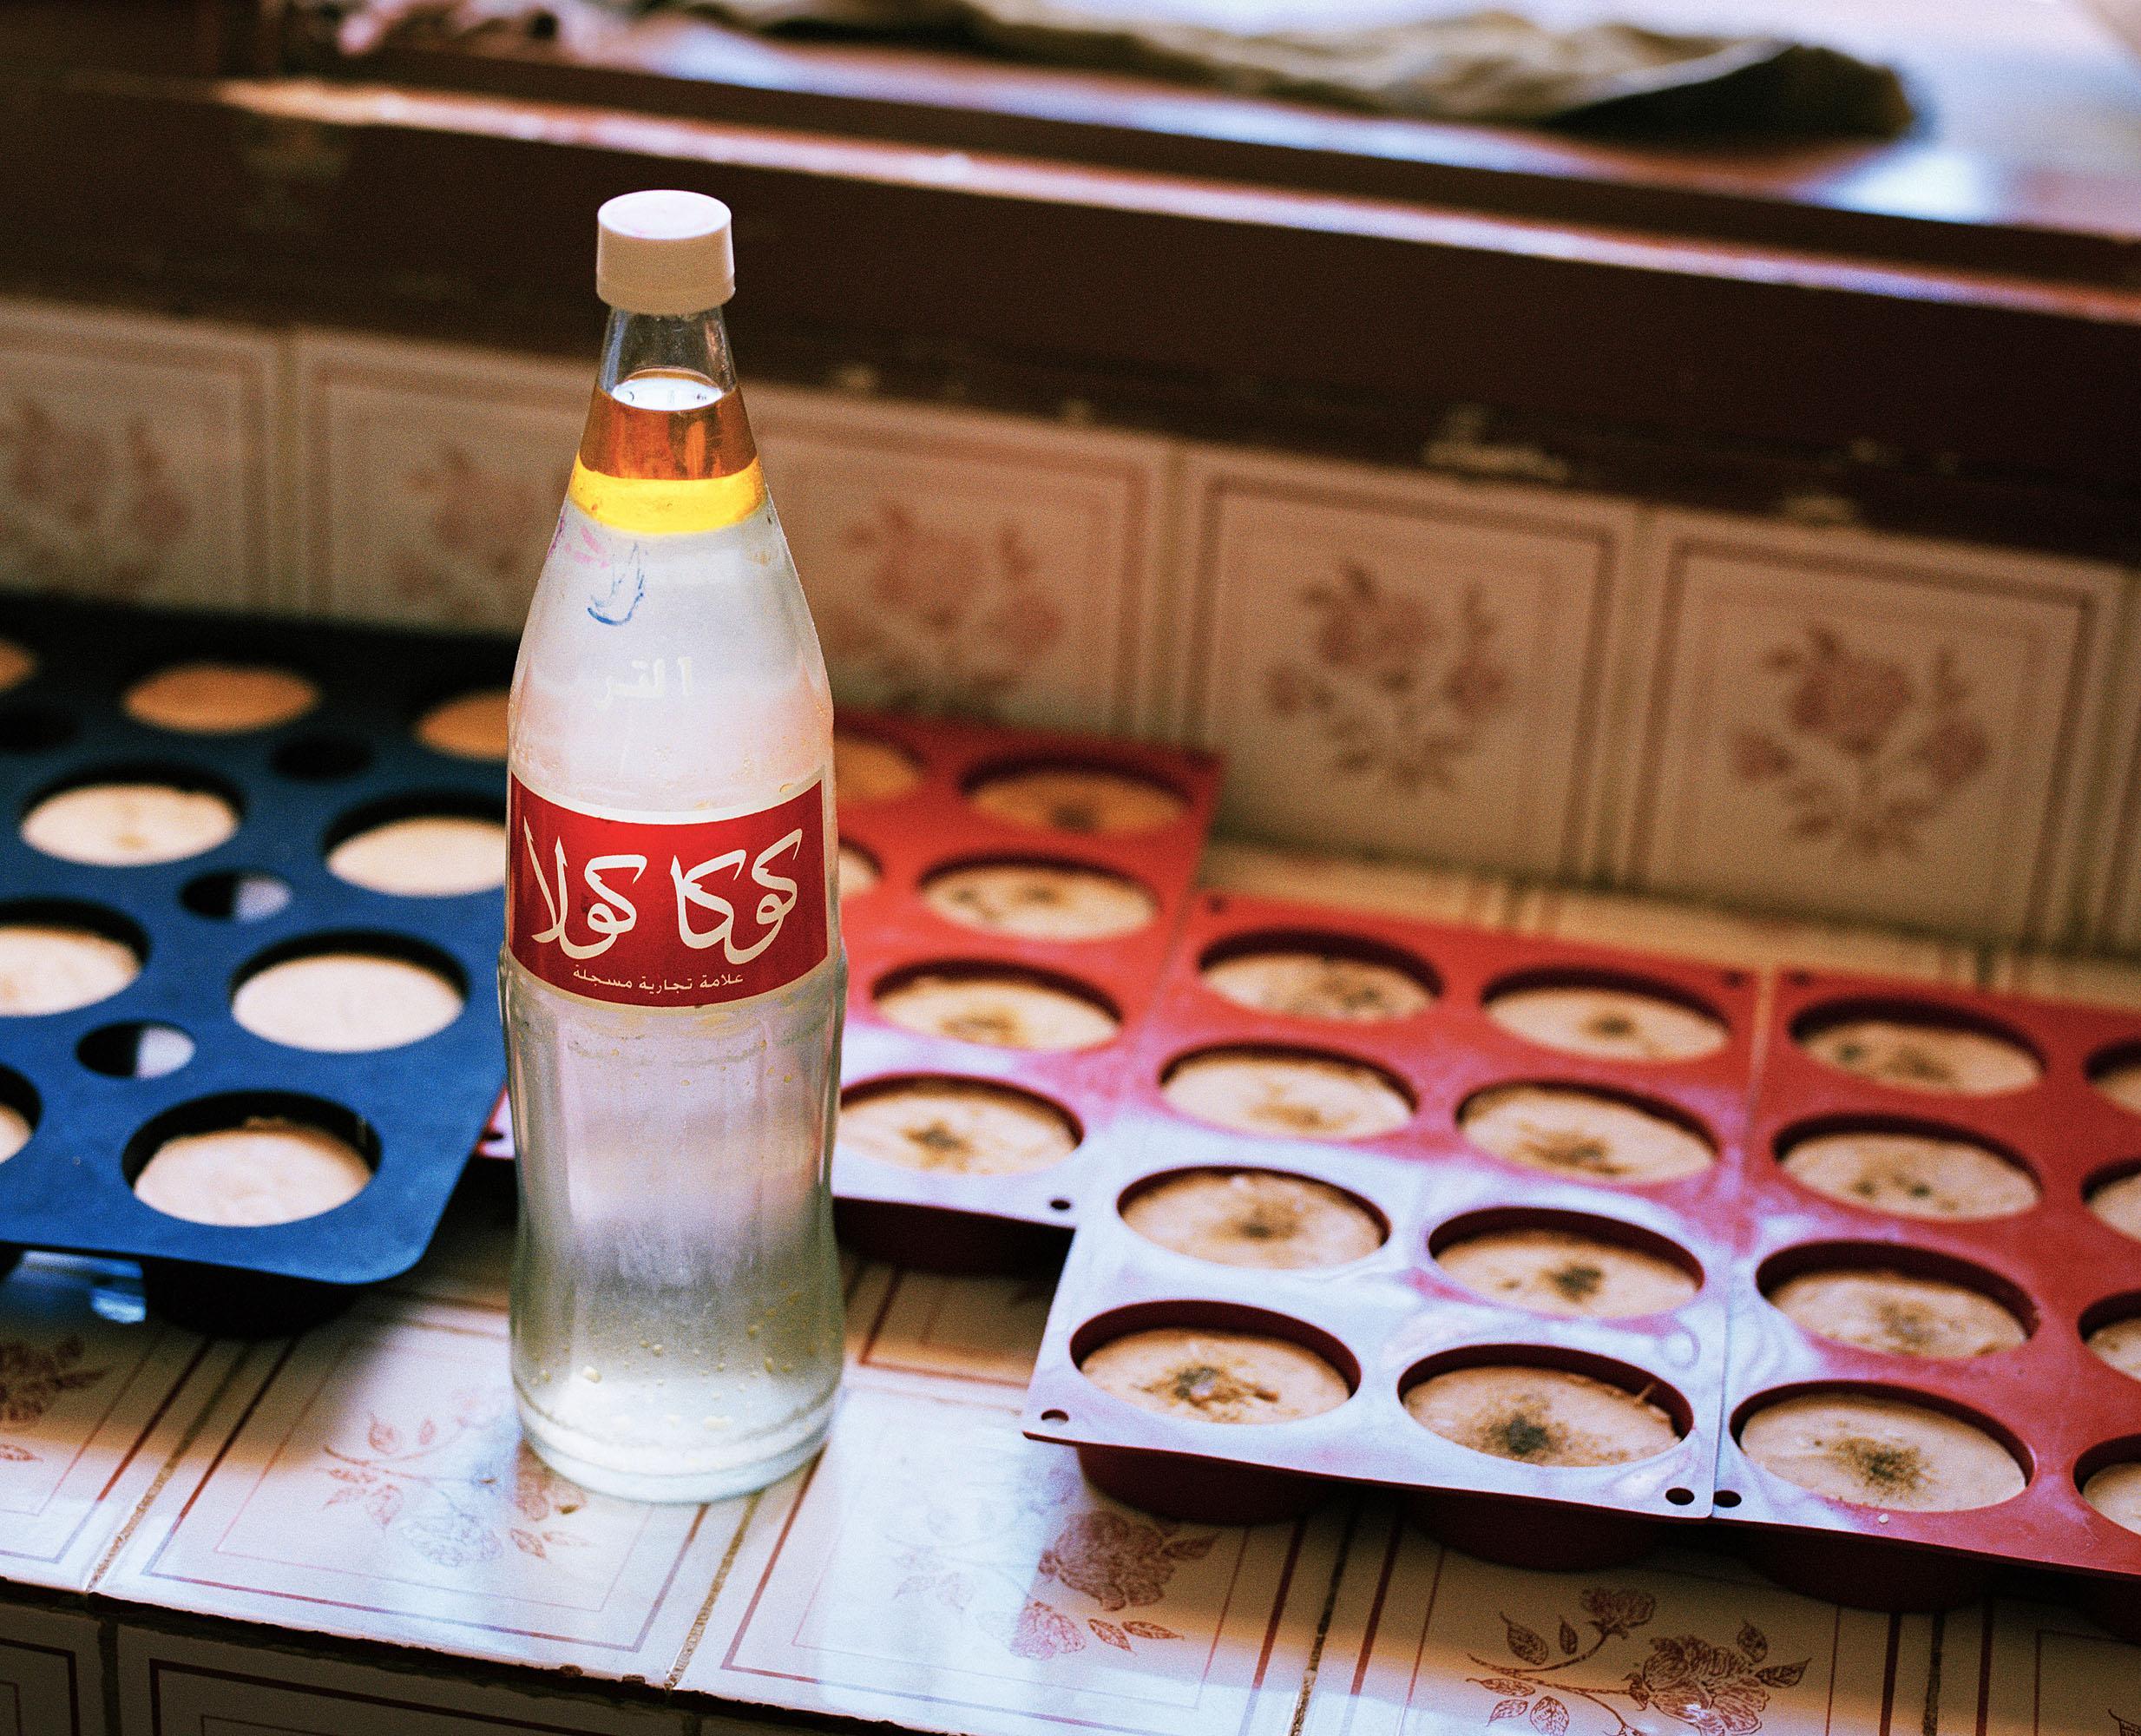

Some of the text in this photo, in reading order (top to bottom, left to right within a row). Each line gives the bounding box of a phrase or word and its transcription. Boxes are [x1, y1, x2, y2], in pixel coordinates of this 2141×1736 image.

[523, 815, 803, 965] كوكا كولا
[573, 963, 745, 995] علامة تجارية مسجلة
